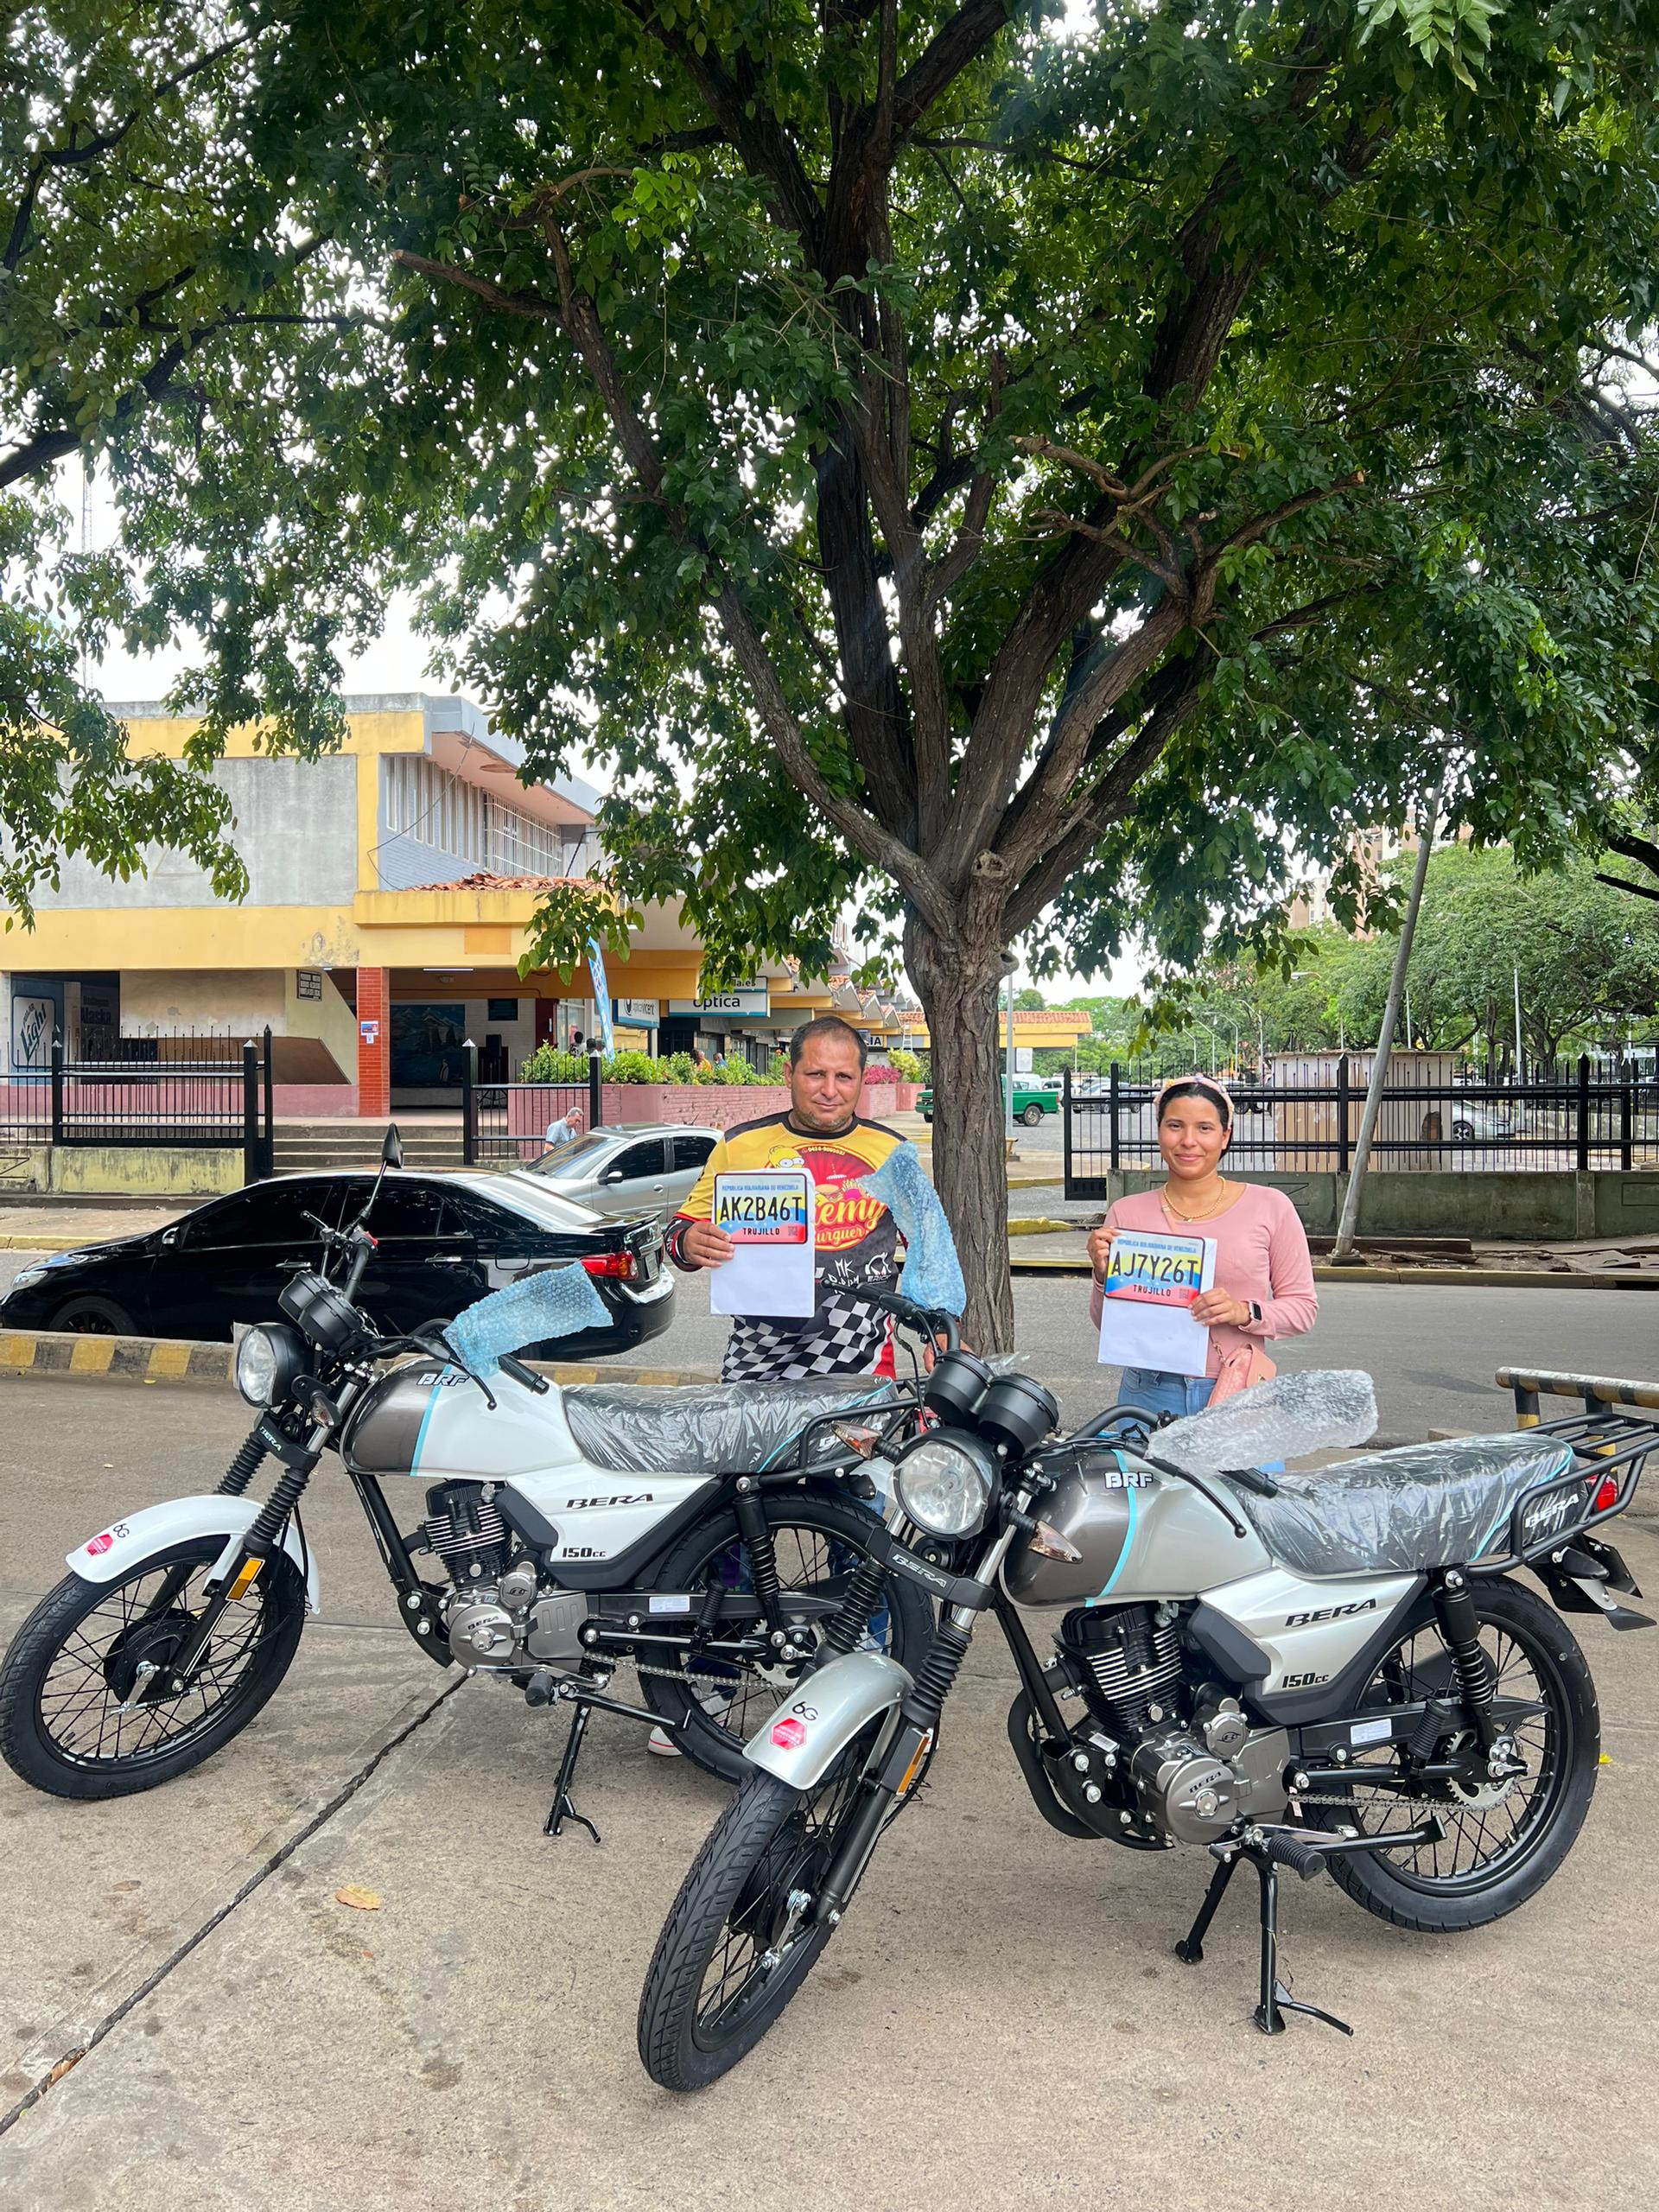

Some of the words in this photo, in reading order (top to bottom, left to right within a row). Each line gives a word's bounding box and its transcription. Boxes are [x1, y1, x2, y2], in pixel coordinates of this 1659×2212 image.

[21, 1002, 48, 1061] Light
[720, 1197, 803, 1221] AK2B46T
[815, 1198, 886, 1230] emy
[743, 1227, 780, 1236] TRUJILLO
[816, 1225, 863, 1245] urguer
[835, 1258, 855, 1278] MK
[1111, 1250, 1199, 1286] AJ7Y26T
[1133, 1284, 1172, 1297] TRUJILLO
[416, 1373, 470, 1387] BRF
[258, 1426, 283, 1452] BERA
[1104, 1471, 1154, 1489] BRF
[566, 1493, 654, 1510] BERA
[1525, 1493, 1580, 1529] BERA
[112, 1522, 130, 1538] 6G
[562, 1547, 607, 1558] 150cc
[892, 1554, 947, 1588] BERA
[467, 1616, 499, 1630] BERA
[1285, 1598, 1376, 1628] BERA
[1281, 1672, 1330, 1688] 150cc
[791, 1700, 819, 1721] 6G
[1189, 1771, 1222, 1794] BERA
